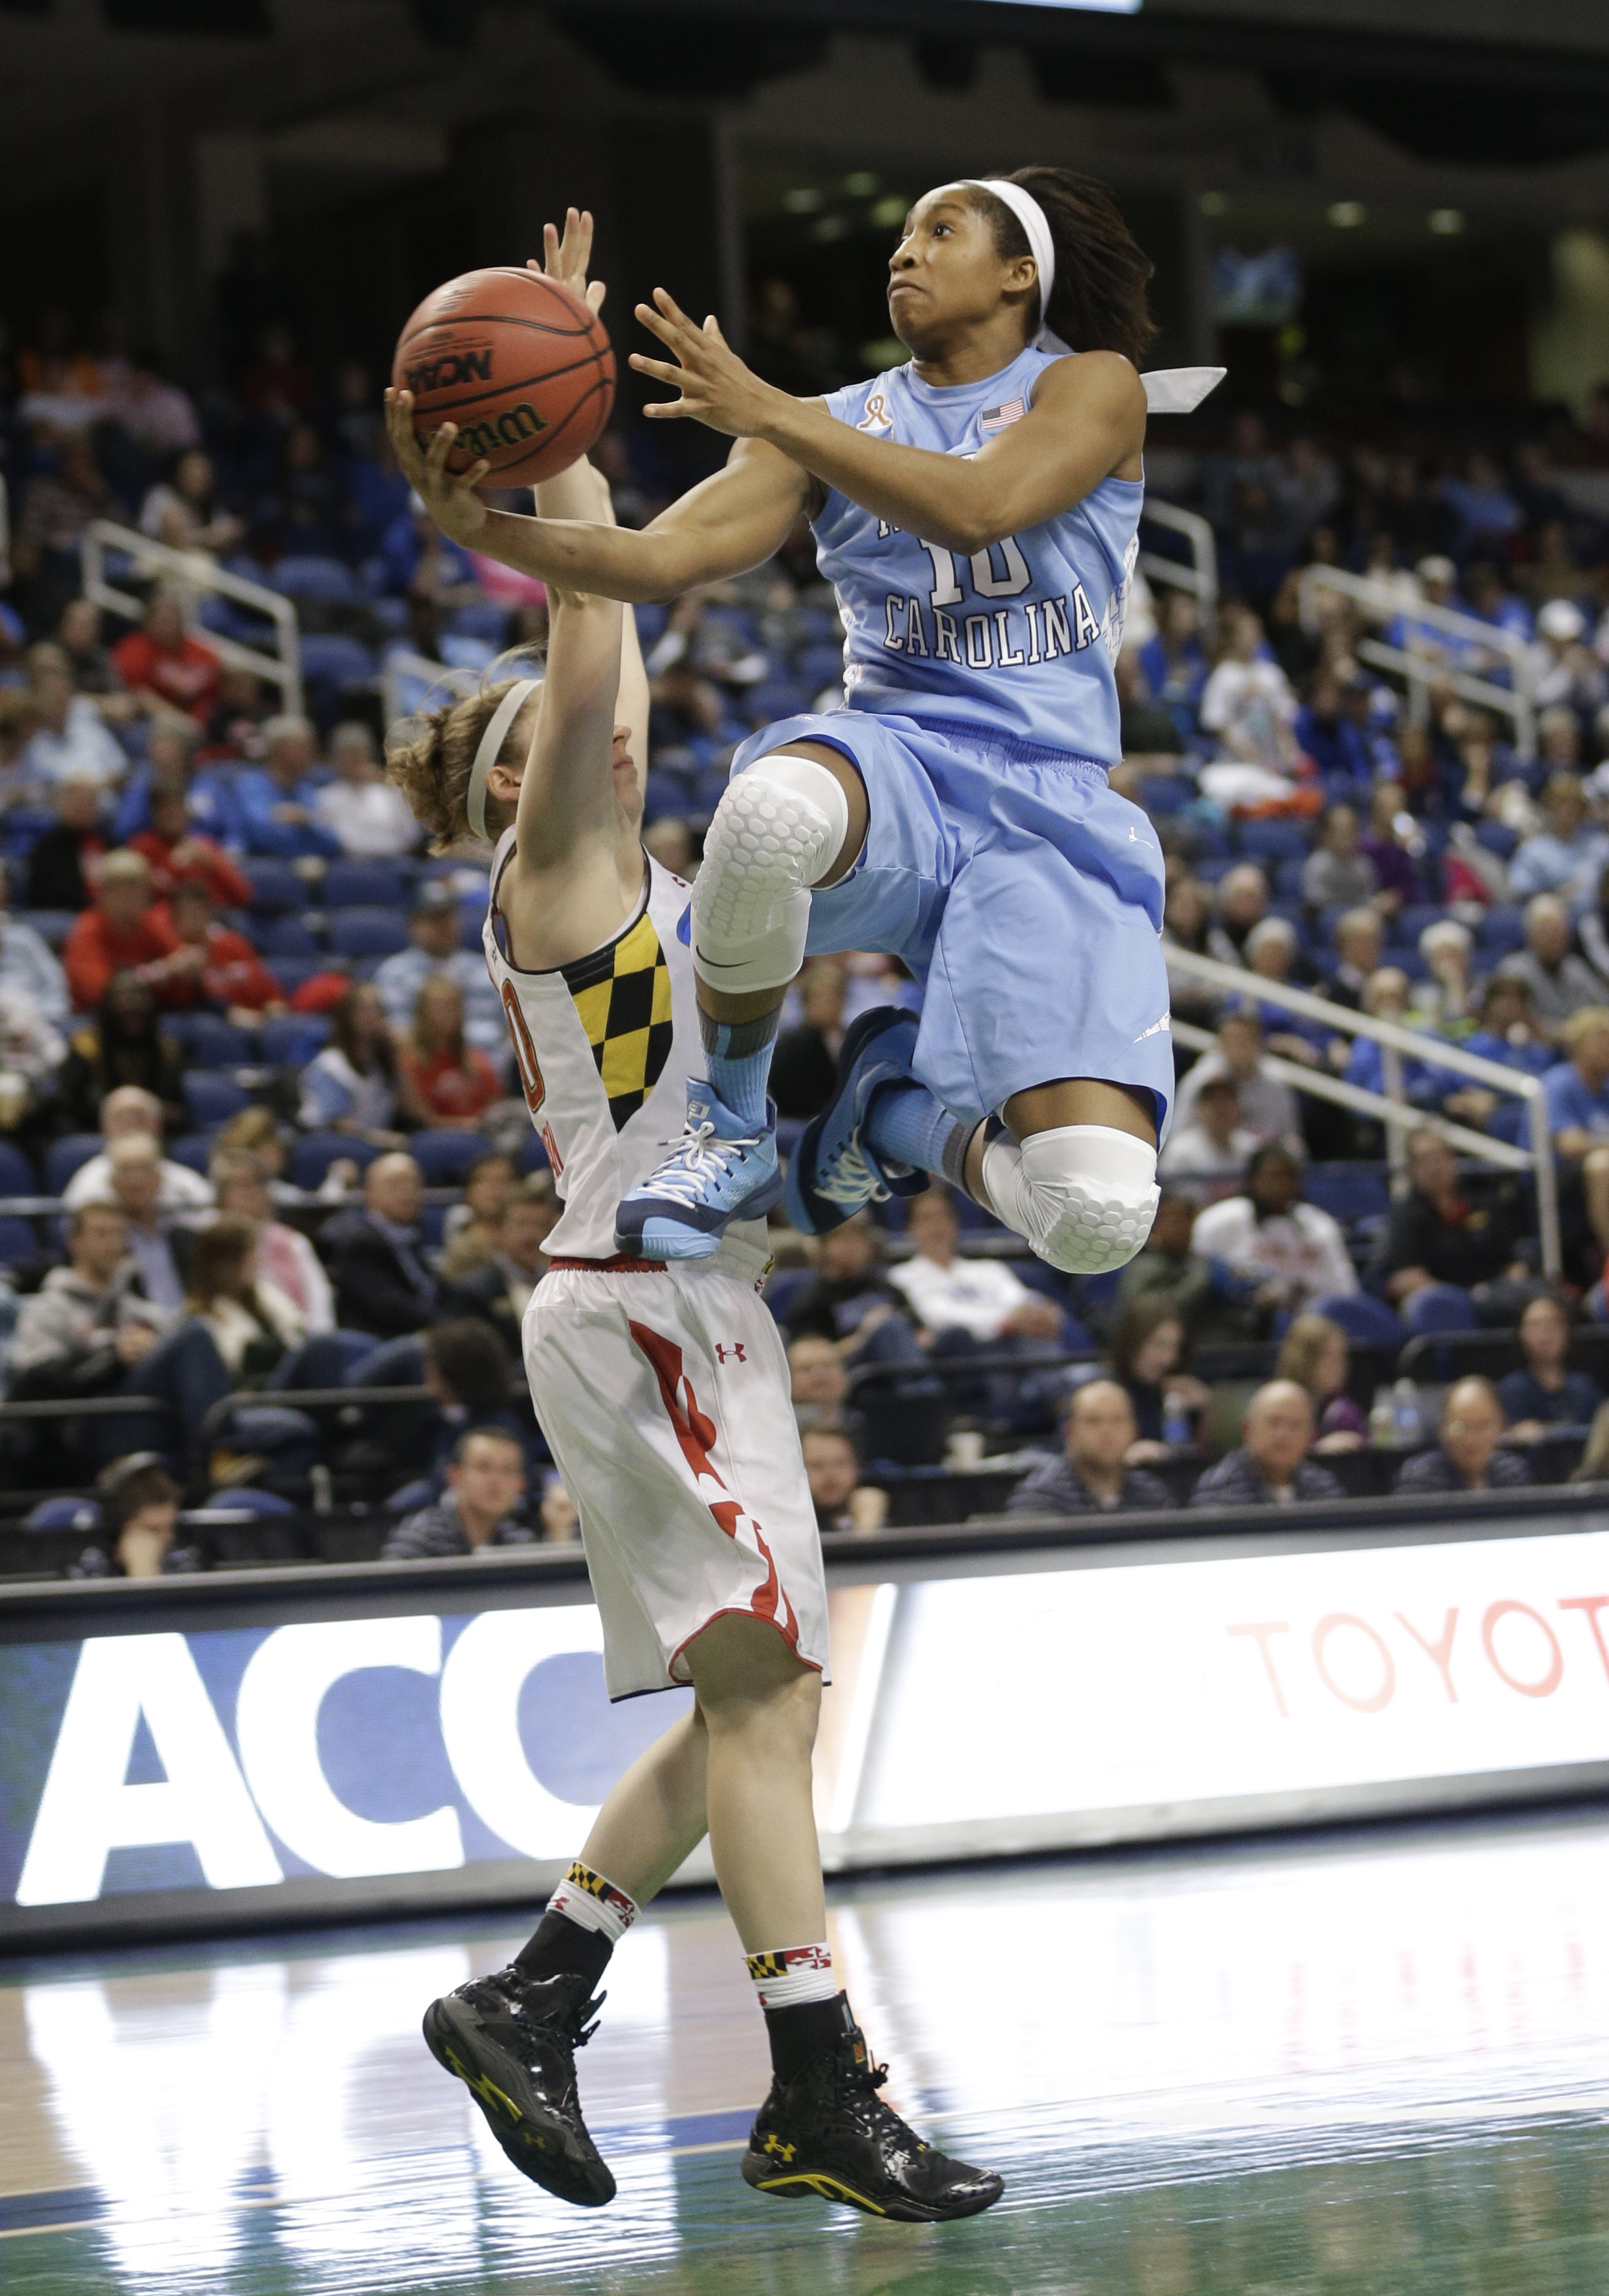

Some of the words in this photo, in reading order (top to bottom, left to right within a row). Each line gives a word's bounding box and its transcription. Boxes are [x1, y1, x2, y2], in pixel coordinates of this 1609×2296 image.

[917, 534, 1033, 606] 10
[884, 580, 1100, 670] CAROLINA
[16, 1603, 604, 1907] ACC
